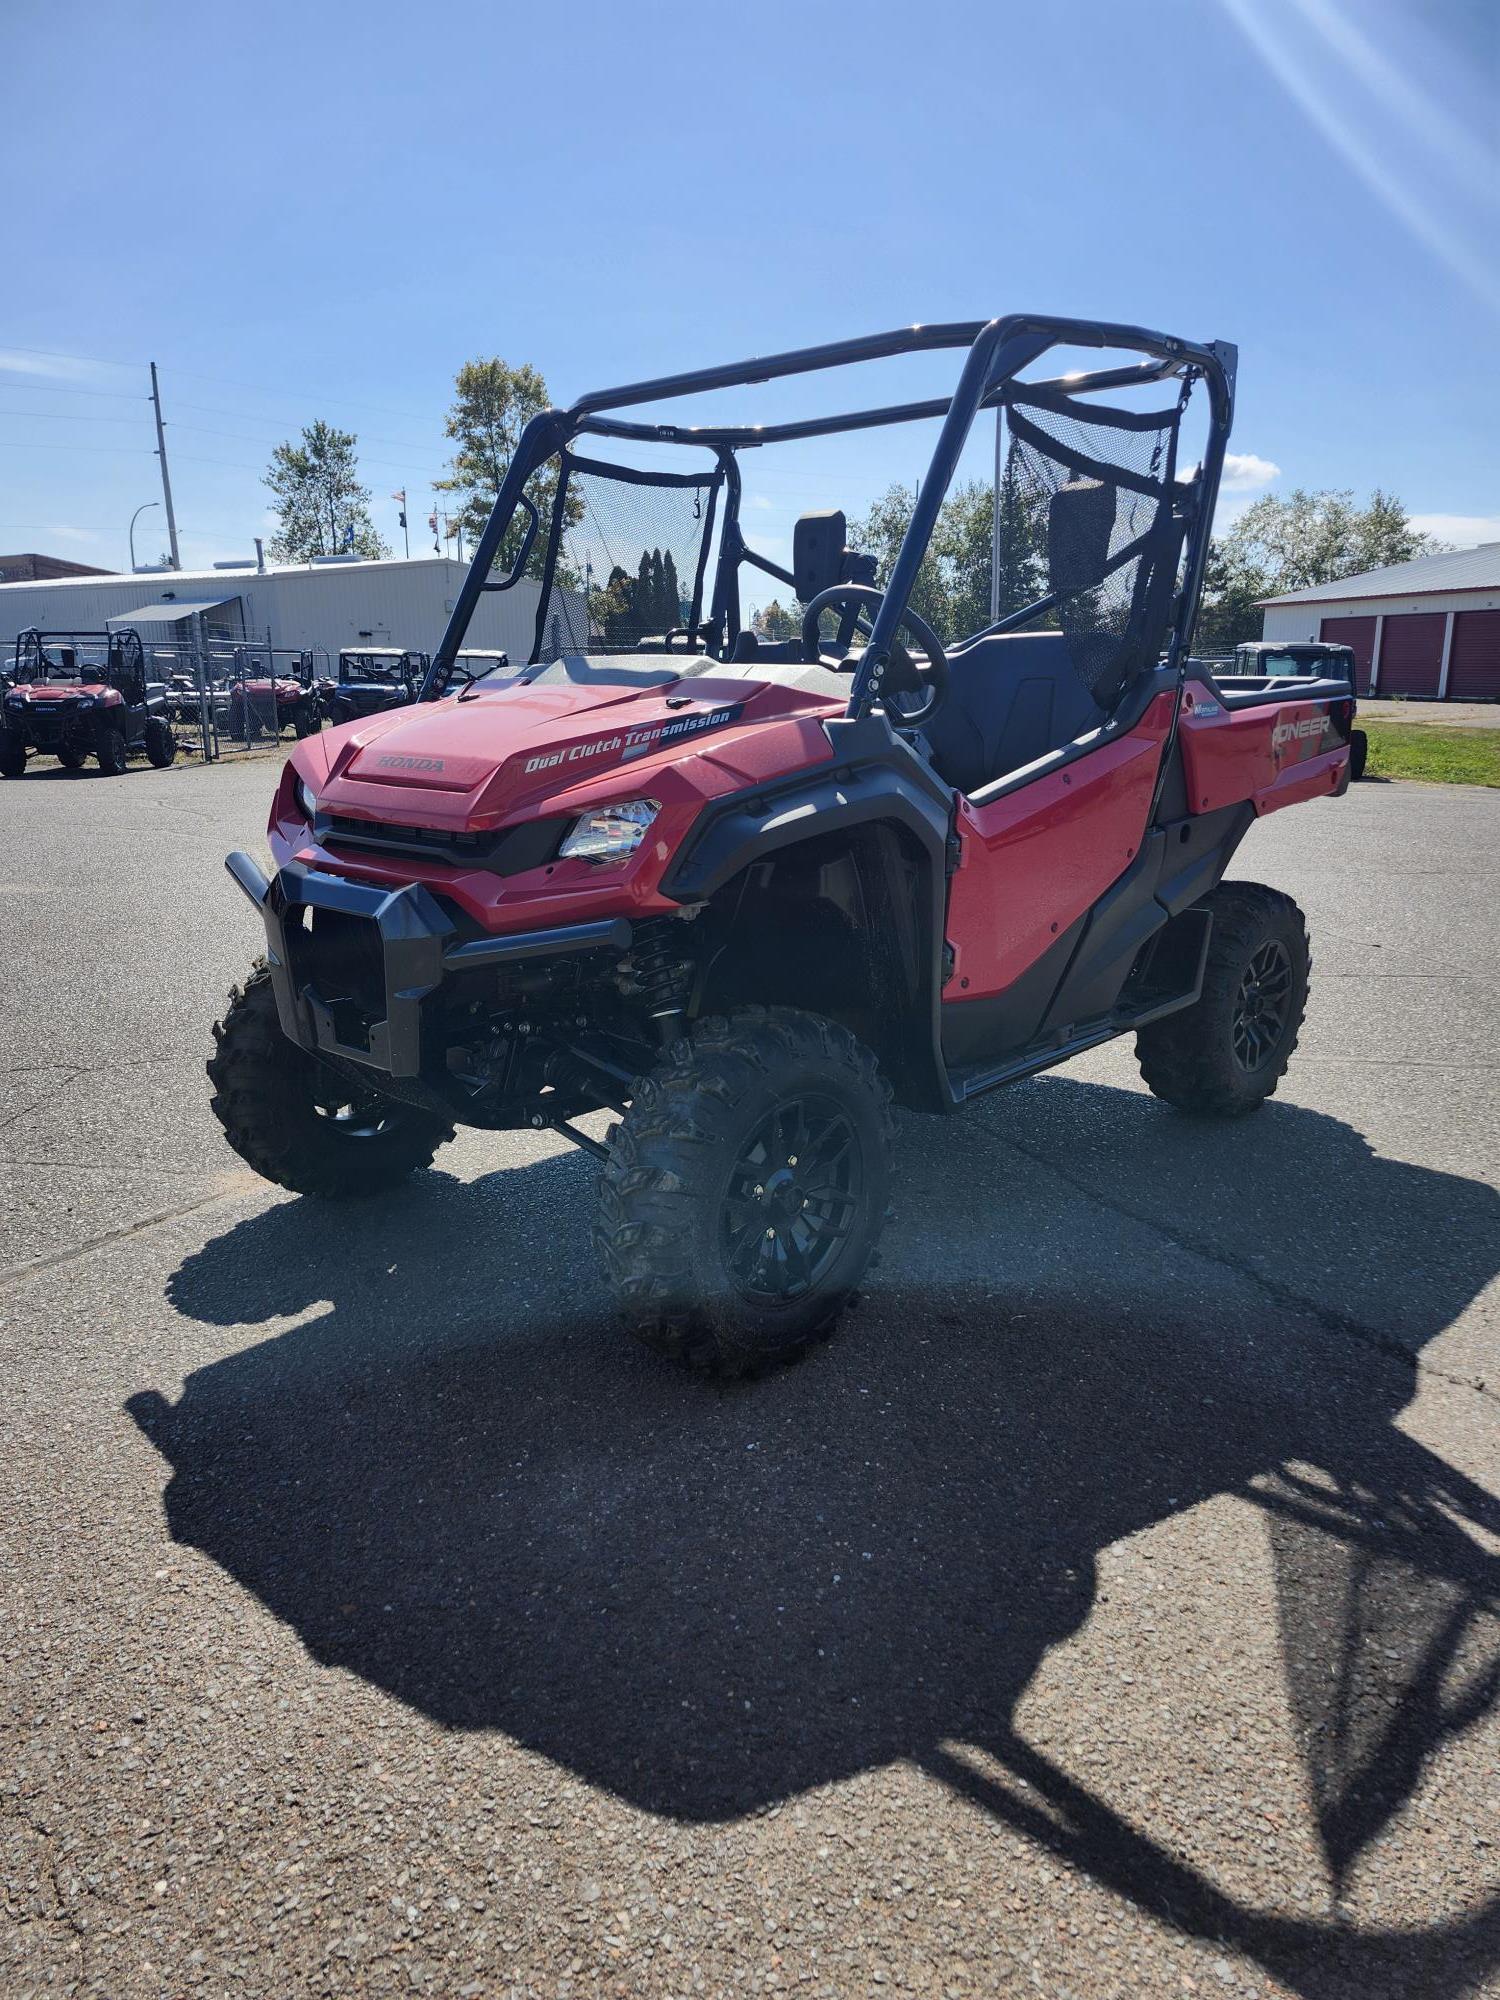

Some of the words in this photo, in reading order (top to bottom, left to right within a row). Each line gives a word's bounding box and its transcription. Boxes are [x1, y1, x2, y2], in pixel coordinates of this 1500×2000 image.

[525, 753, 565, 774] Dual
[568, 736, 622, 761] Clutch
[624, 711, 730, 746] Transmission
[378, 755, 445, 772] HONDA
